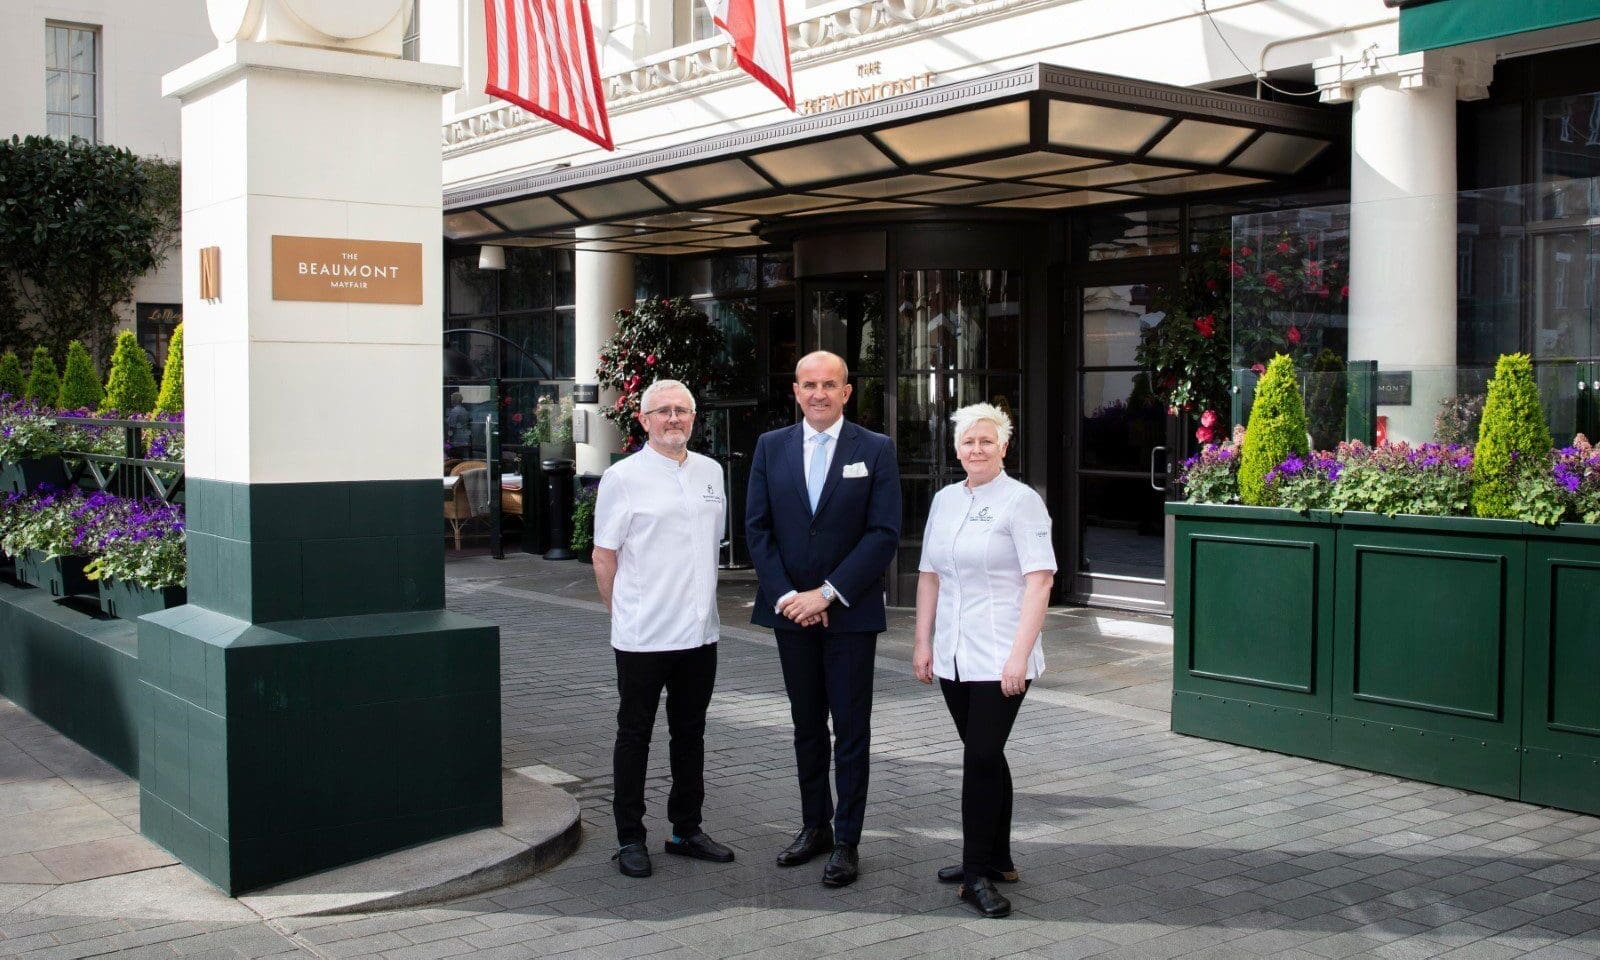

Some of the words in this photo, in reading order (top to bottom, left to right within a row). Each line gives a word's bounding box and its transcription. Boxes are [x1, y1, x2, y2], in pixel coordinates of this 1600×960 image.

[341, 252, 359, 260] THE
[298, 262, 399, 279] BEAUMONT
[330, 281, 368, 289] MAYFAIR
